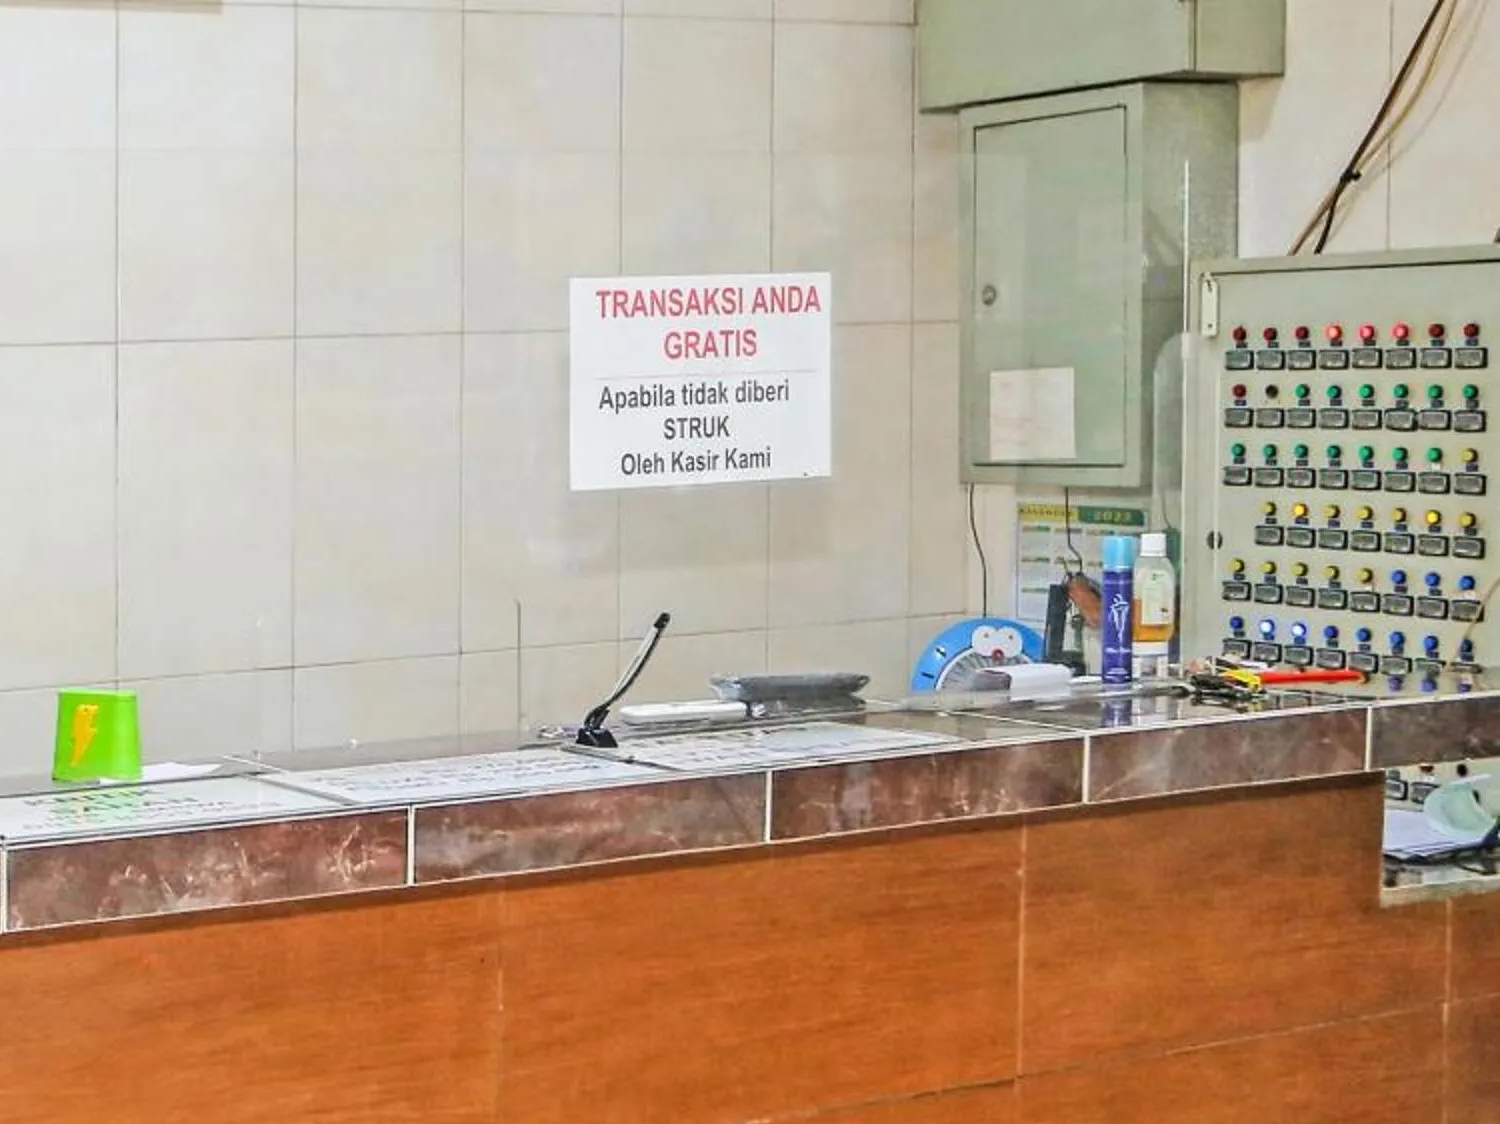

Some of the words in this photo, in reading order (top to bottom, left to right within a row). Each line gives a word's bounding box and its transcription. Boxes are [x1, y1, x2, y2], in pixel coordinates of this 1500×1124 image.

[596, 287, 744, 319] TRANSAKSI
[751, 285, 821, 314] ANDA
[663, 329, 758, 360] GRATIS
[598, 383, 675, 415] Apabila
[681, 381, 728, 407] tidak
[735, 378, 790, 404] diberi
[663, 415, 730, 440] STRUK
[621, 451, 665, 475] Oleh
[671, 449, 719, 473] Kasir
[725, 446, 772, 470] Kami
